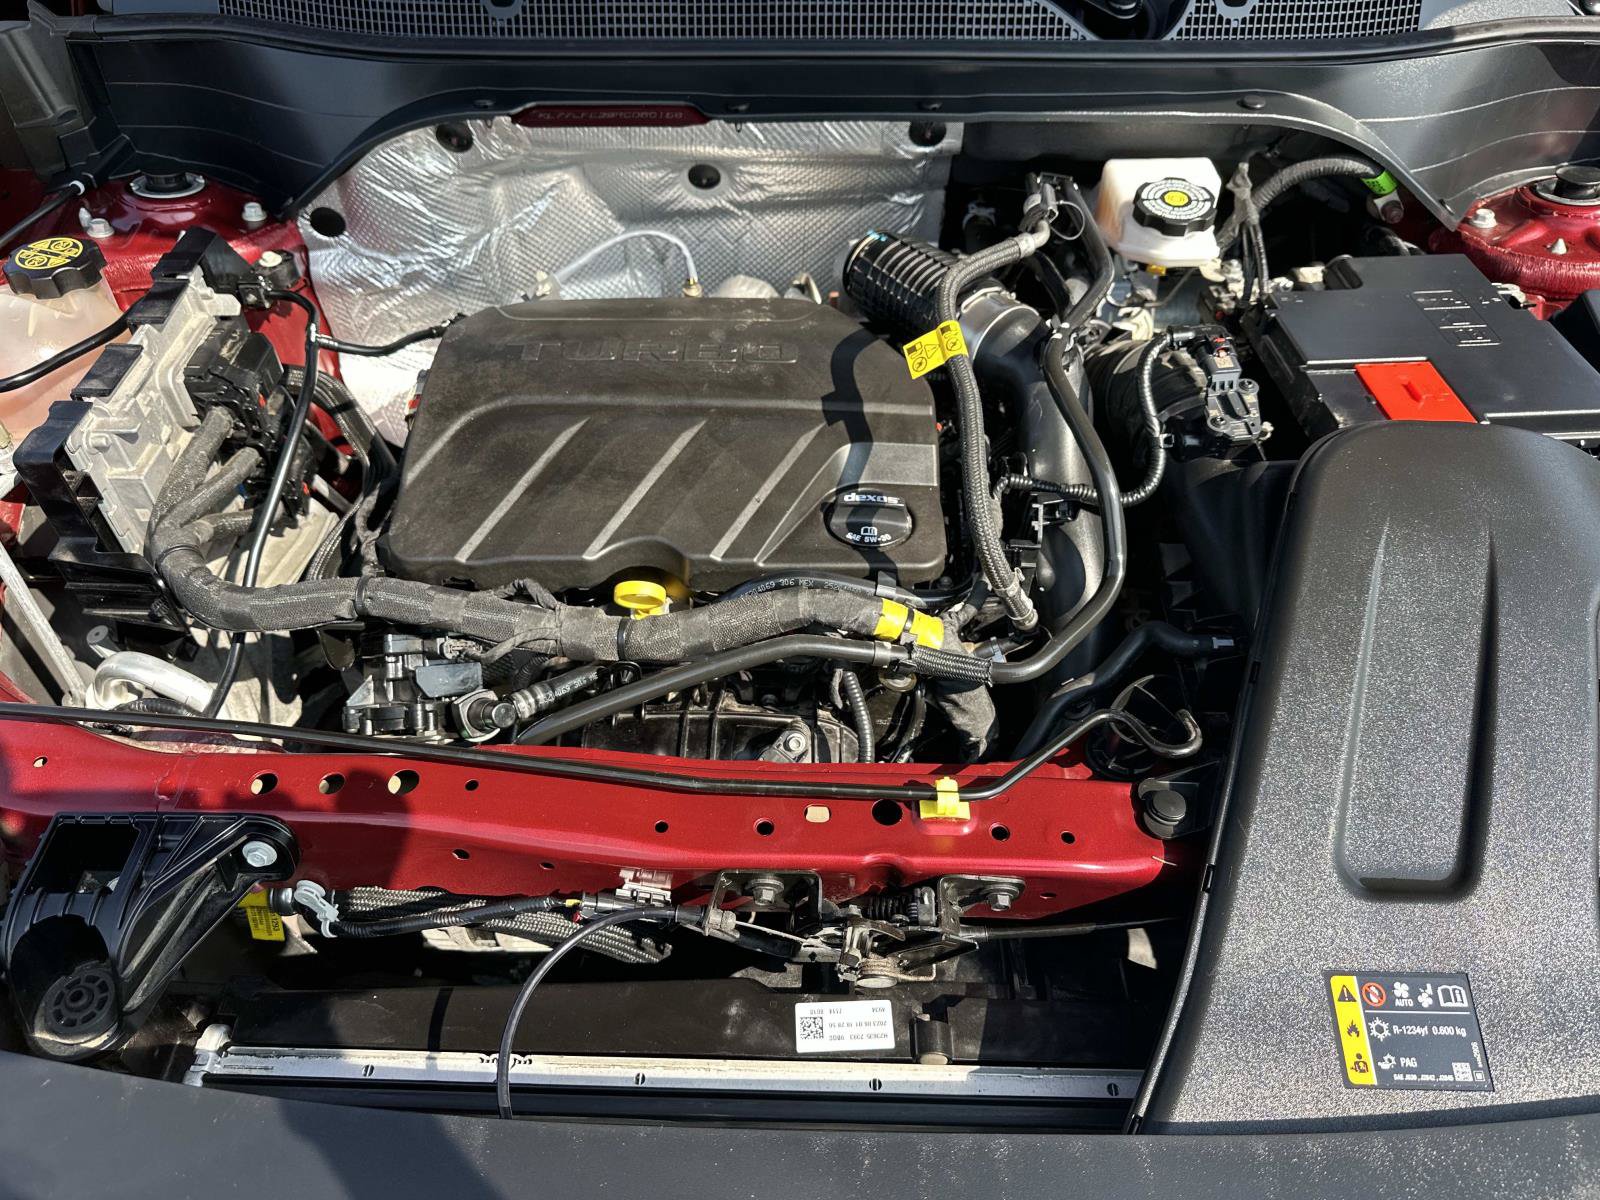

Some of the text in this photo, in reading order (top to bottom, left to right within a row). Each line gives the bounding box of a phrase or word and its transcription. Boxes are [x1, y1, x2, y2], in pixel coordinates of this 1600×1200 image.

[508, 341, 800, 364] TURBO
[843, 492, 900, 505] dexos
[845, 531, 892, 544] SAE 5W-30
[798, 578, 814, 588] MEX
[1395, 998, 1414, 1007] AUTO
[1392, 1024, 1467, 1038] R-1234yf 0.600 kg
[1399, 1056, 1418, 1069] PAG
